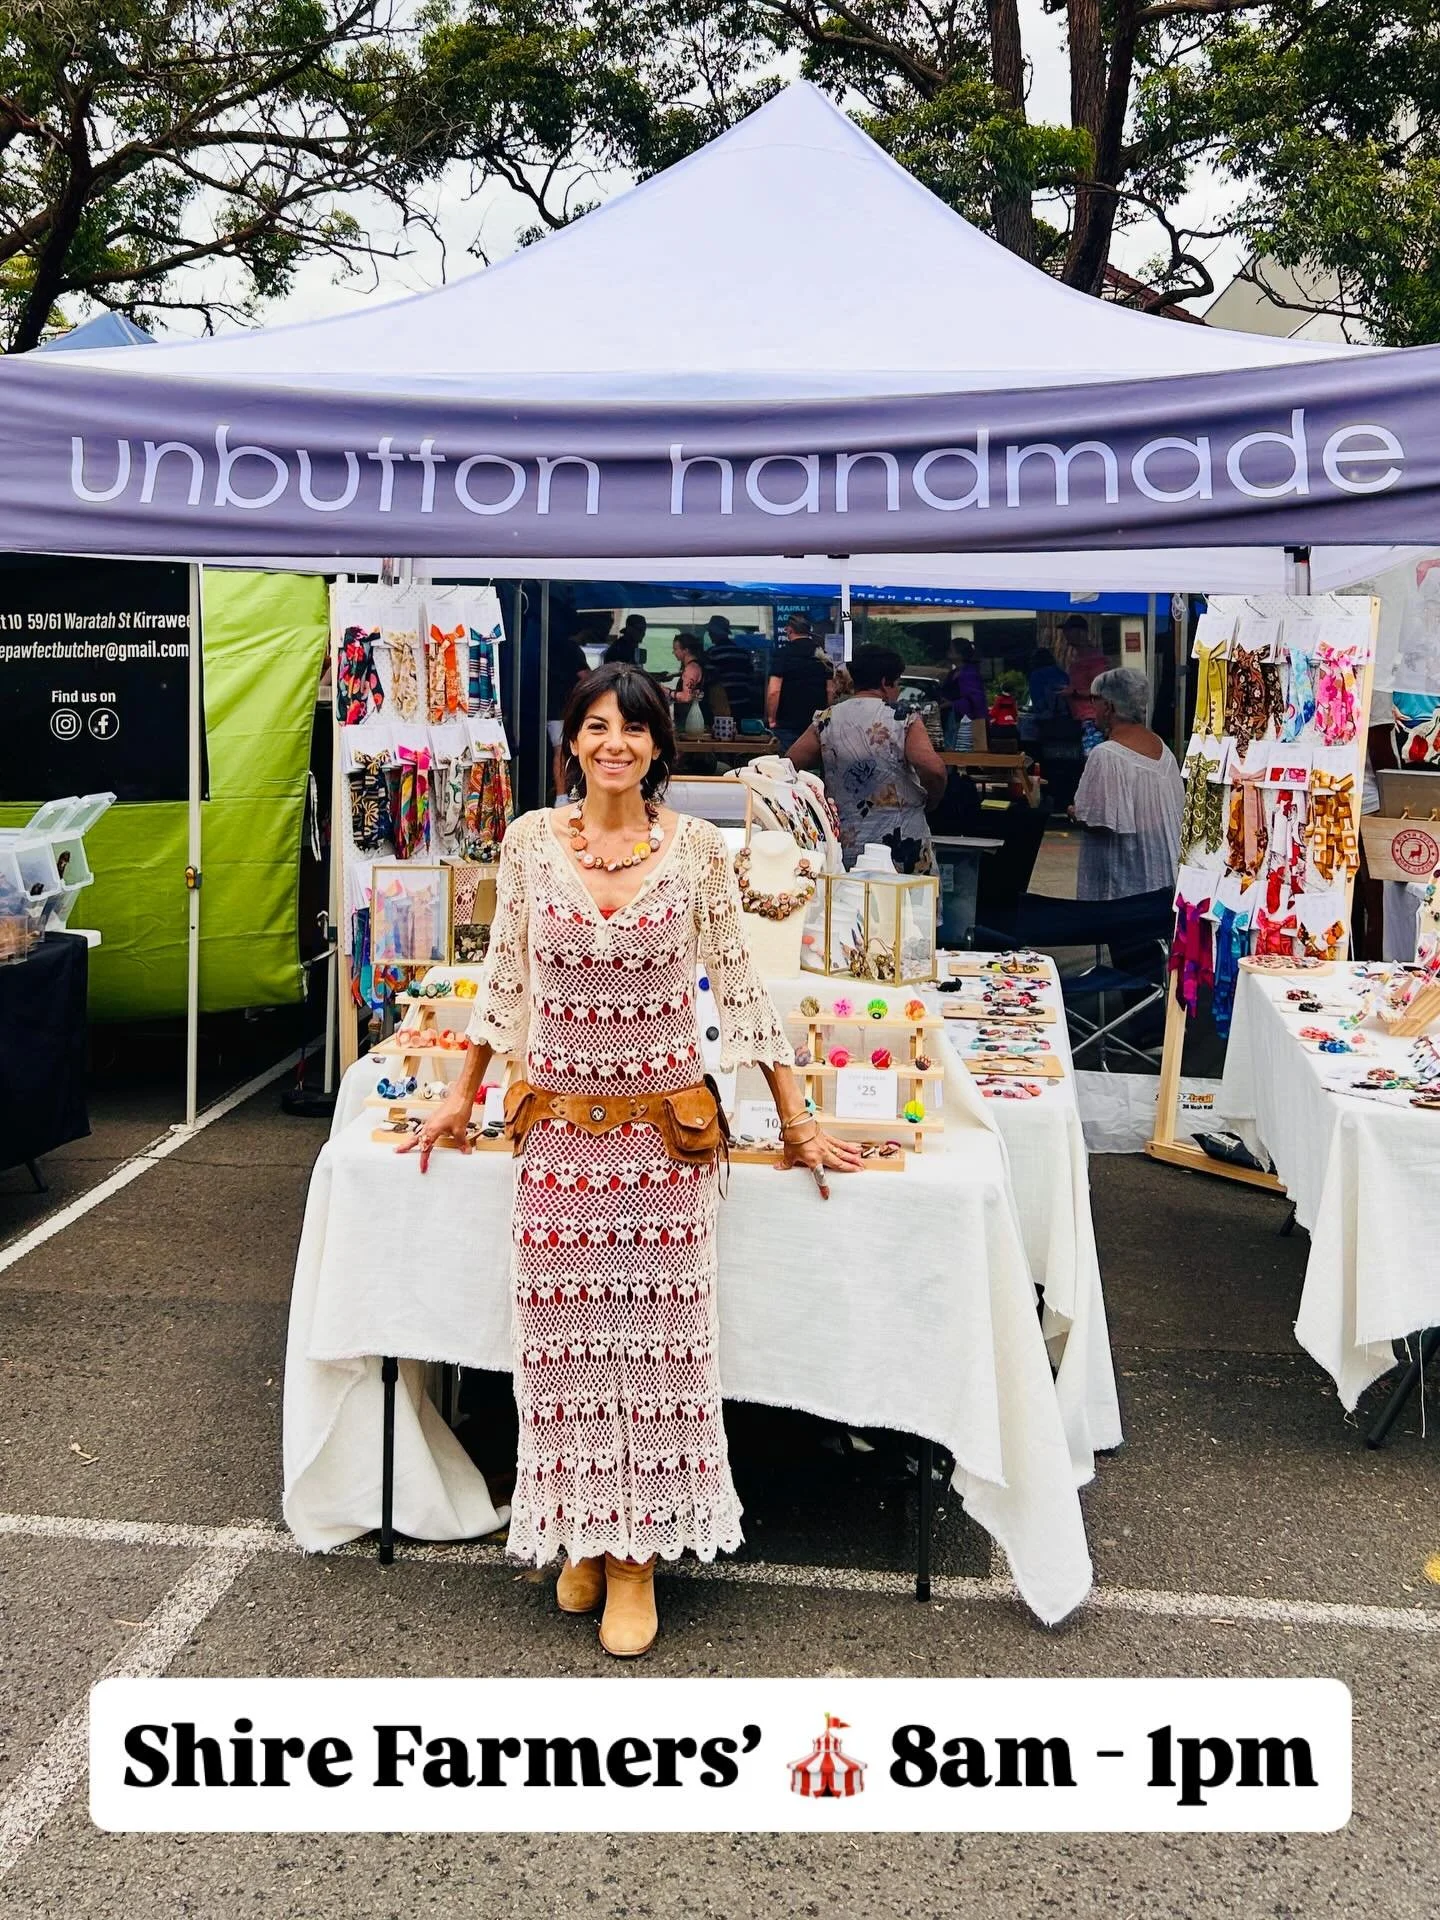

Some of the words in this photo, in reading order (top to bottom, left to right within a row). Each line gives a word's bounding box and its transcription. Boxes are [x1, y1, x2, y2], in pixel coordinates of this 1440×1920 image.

[71, 425, 599, 515] unbutton
[668, 409, 1405, 515] handmade
[27, 612, 61, 630] 59/61
[64, 611, 116, 630] Waratah
[118, 612, 132, 629] St
[51, 690, 79, 703] Find
[82, 693, 97, 703] us
[99, 693, 116, 703] on
